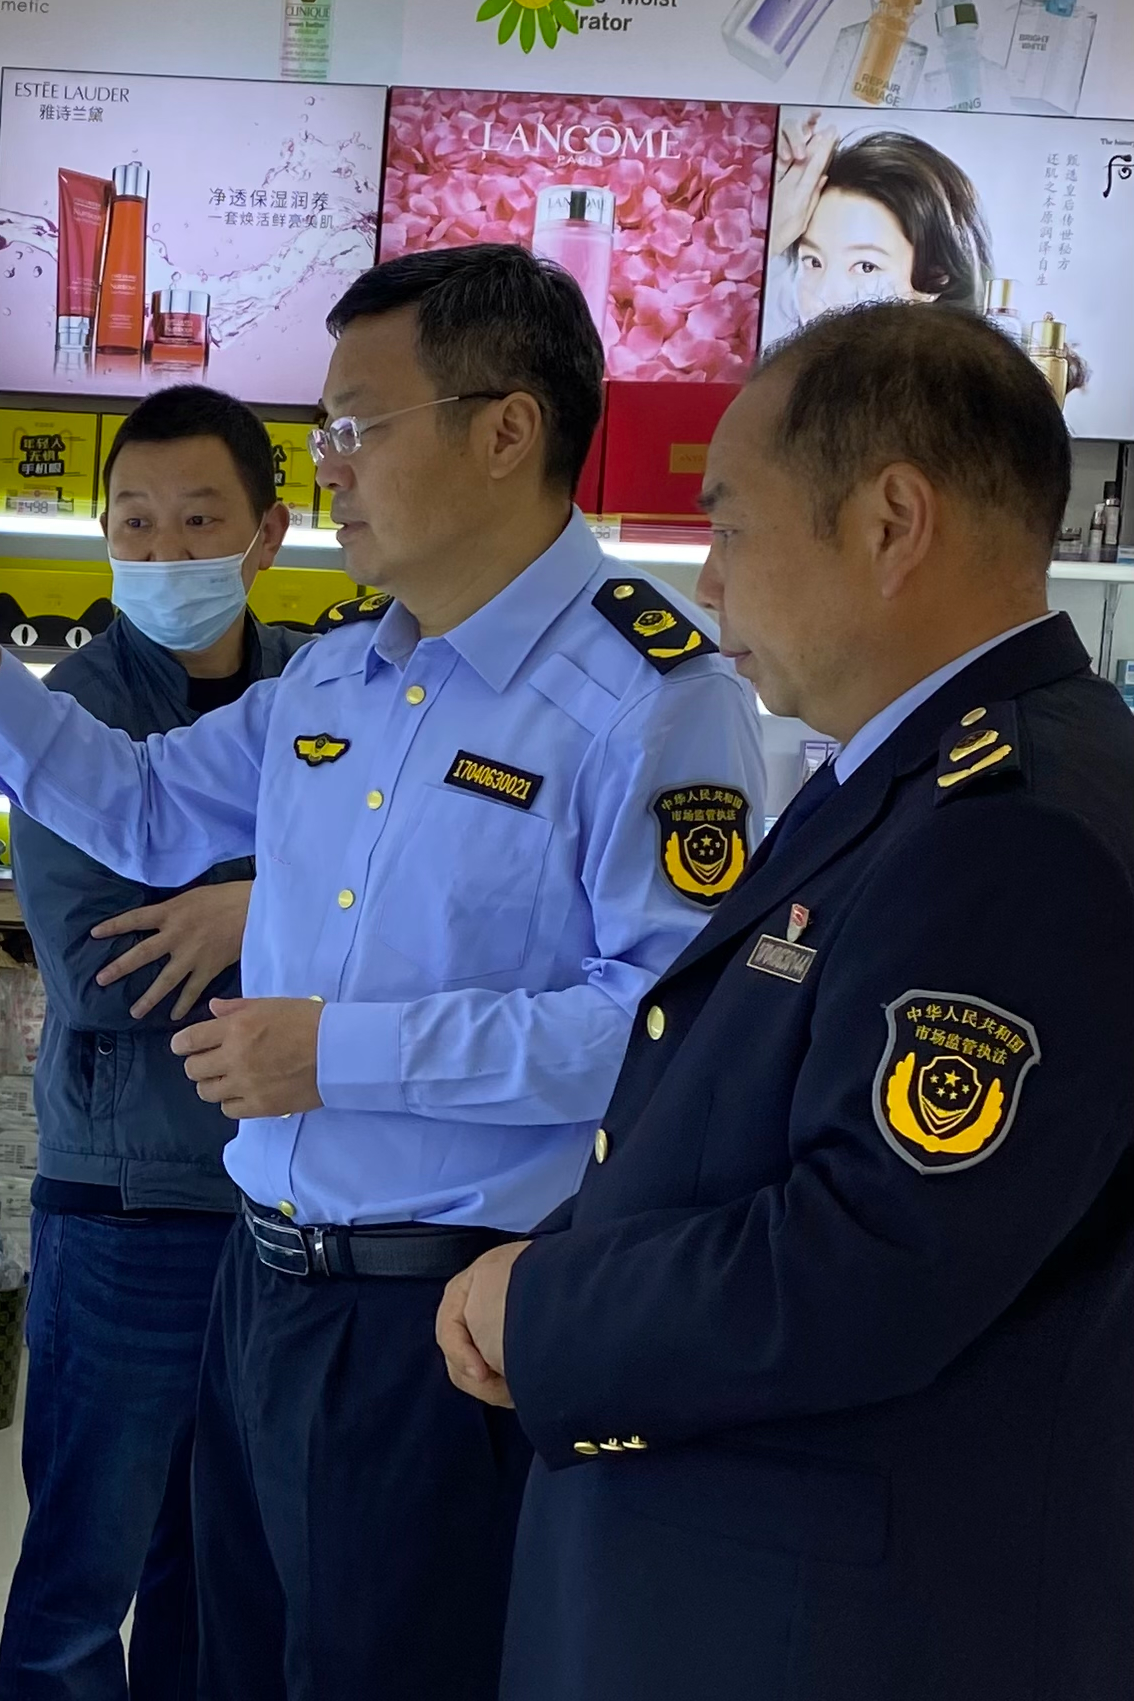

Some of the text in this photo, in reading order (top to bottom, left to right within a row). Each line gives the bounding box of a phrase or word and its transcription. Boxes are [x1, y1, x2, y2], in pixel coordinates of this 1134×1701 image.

[1018, 33, 1050, 44] BRIGHT
[1021, 42, 1048, 51] WHITE
[64, 86, 130, 102] LAUDER
[854, 81, 900, 107] DAMAGE
[861, 73, 901, 95] REPAIR
[39, 104, 104, 122] 雅诗兰黛
[557, 154, 604, 167] PARIS
[208, 187, 330, 211] 净透保湿润养
[24, 500, 49, 514] 498
[452, 758, 533, 801] 17040630021
[661, 788, 744, 811] 中华人民共和国
[671, 808, 737, 821] 市场监管执法
[906, 1003, 1026, 1053] 中华人民共和国
[915, 1024, 1008, 1066] 市场监管执法
